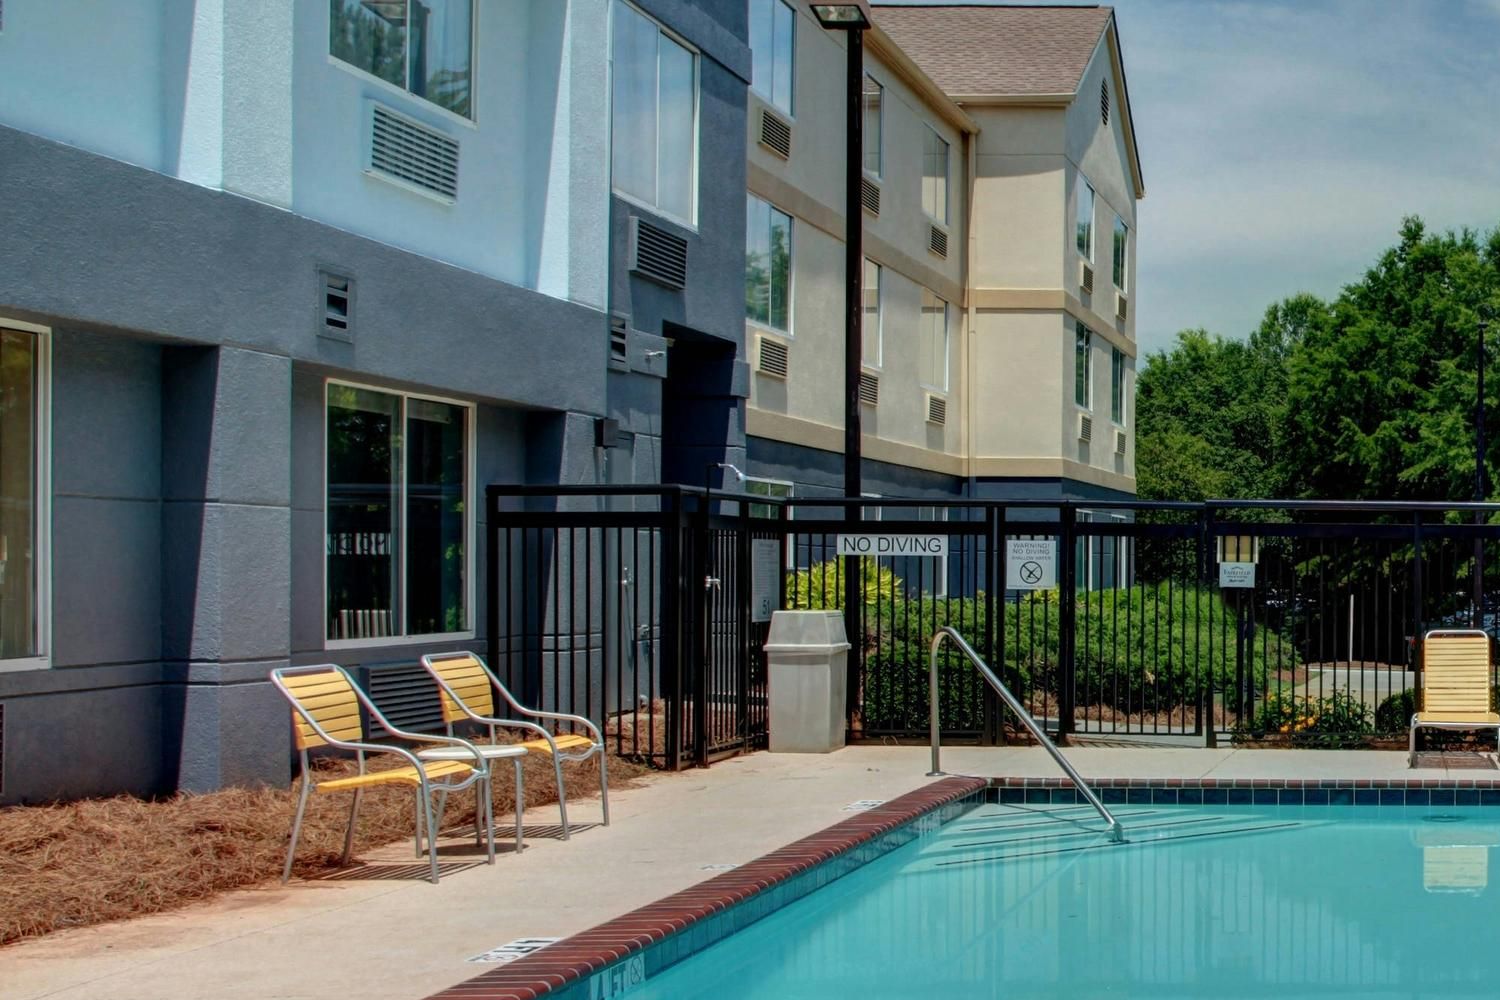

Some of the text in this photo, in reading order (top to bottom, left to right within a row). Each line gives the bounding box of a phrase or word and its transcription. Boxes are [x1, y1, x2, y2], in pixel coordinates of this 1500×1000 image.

[843, 537, 942, 553] NO DIVING
[610, 962, 626, 998] FT
